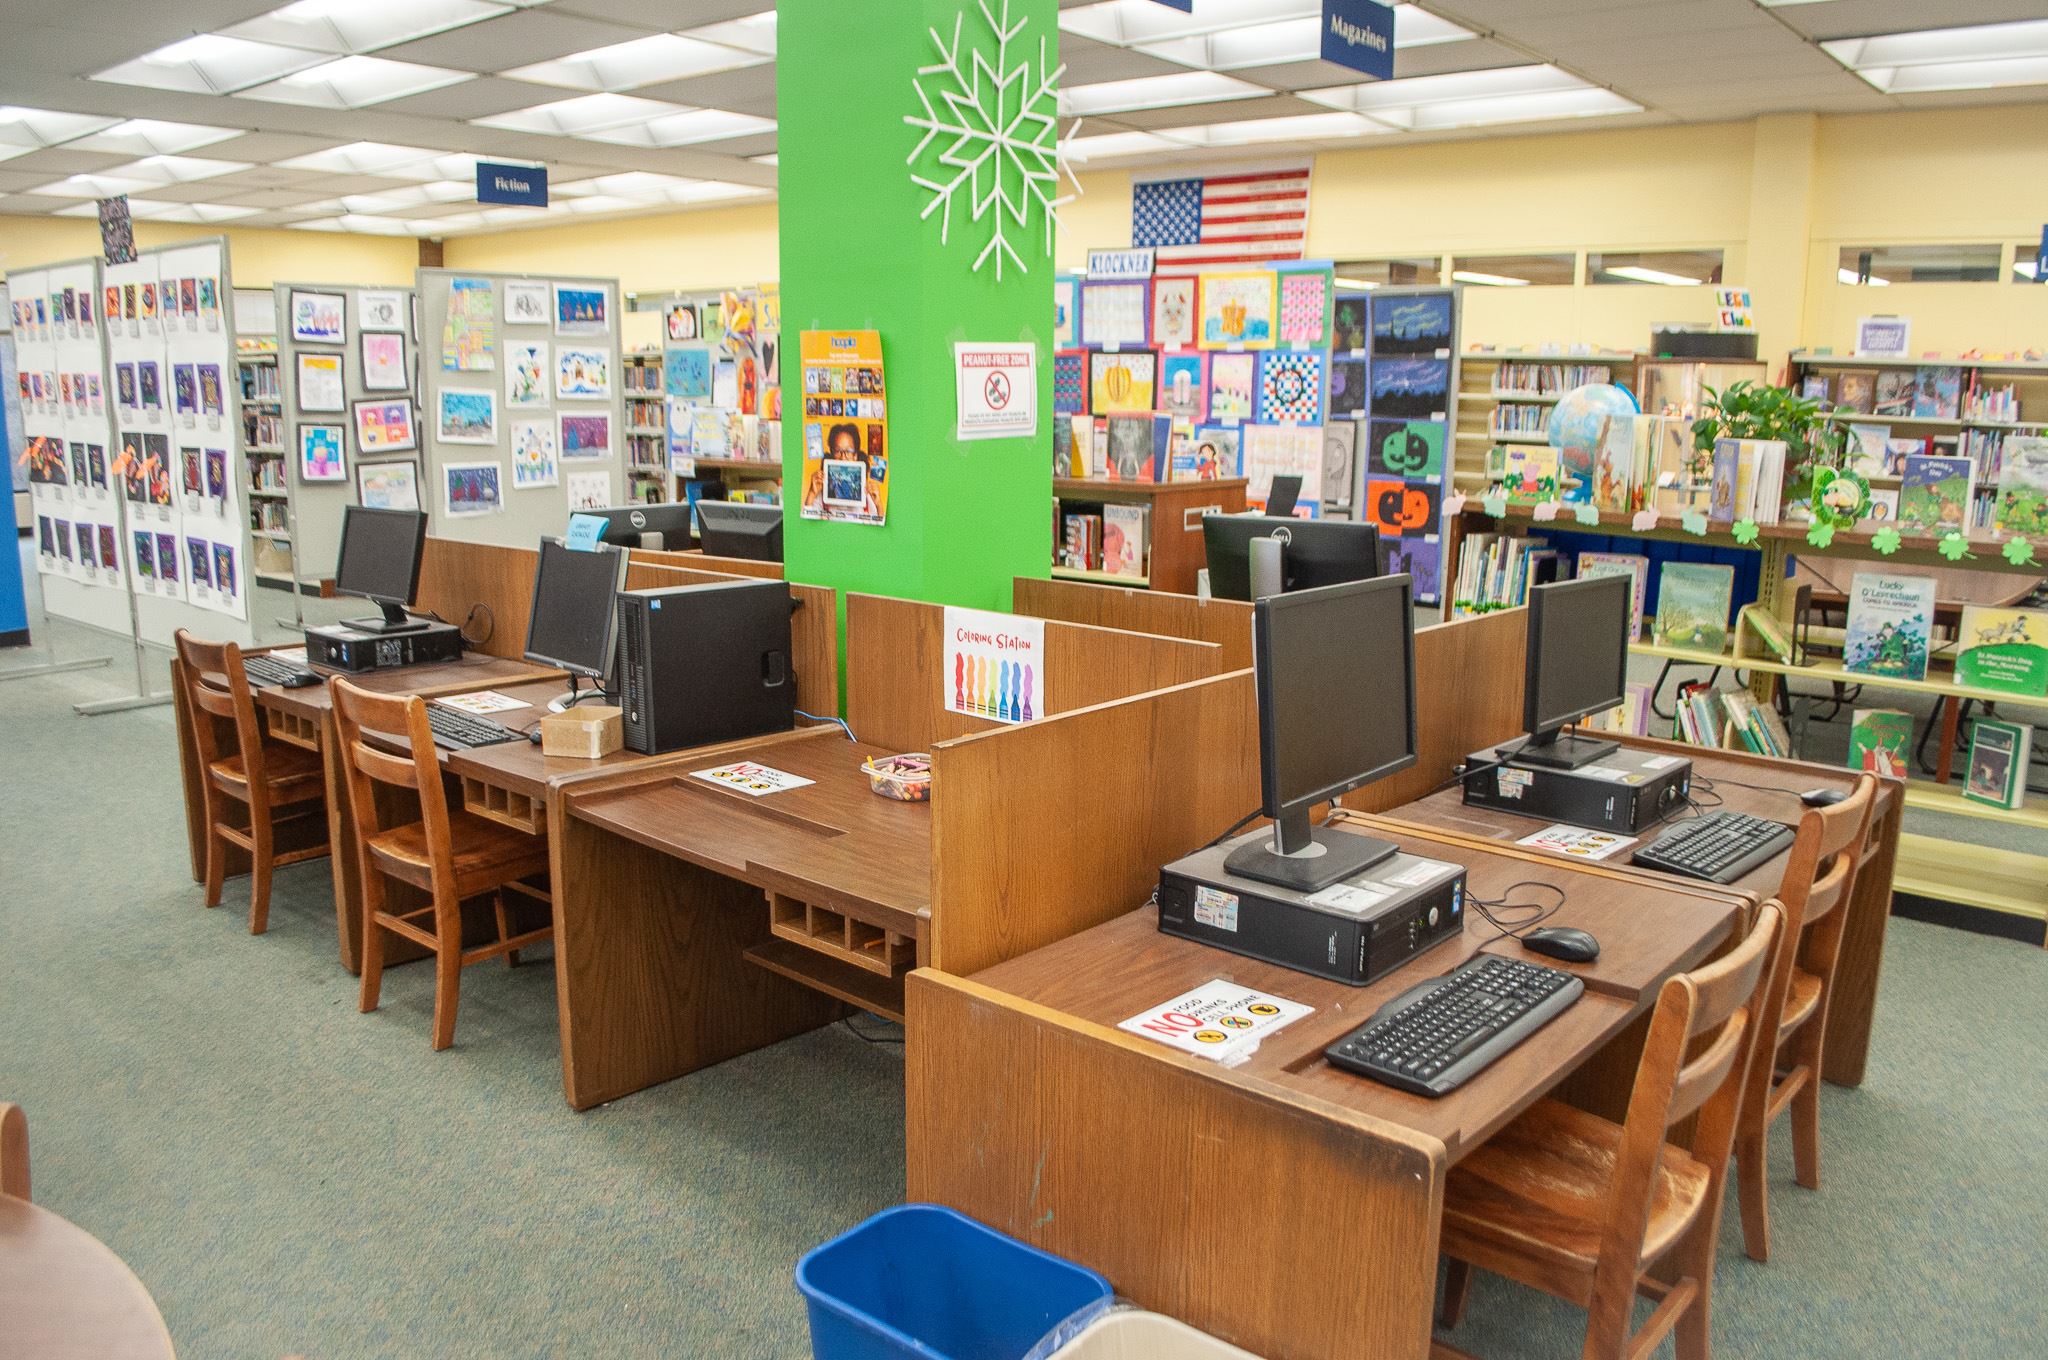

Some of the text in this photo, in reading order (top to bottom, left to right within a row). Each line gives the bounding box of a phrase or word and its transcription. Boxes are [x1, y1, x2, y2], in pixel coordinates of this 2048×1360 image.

[1330, 13, 1387, 53] Magazines
[495, 175, 531, 194] Fiction
[1091, 253, 1149, 273] KLOCKNER
[1716, 291, 1751, 307] LEGO
[1721, 311, 1752, 328] Club
[1879, 580, 1904, 590] Lucky
[1173, 998, 1203, 1013] FOOD
[1187, 999, 1228, 1018] DRINKS
[1229, 994, 1261, 1012] PHONE
[1141, 1012, 1204, 1038] NO
